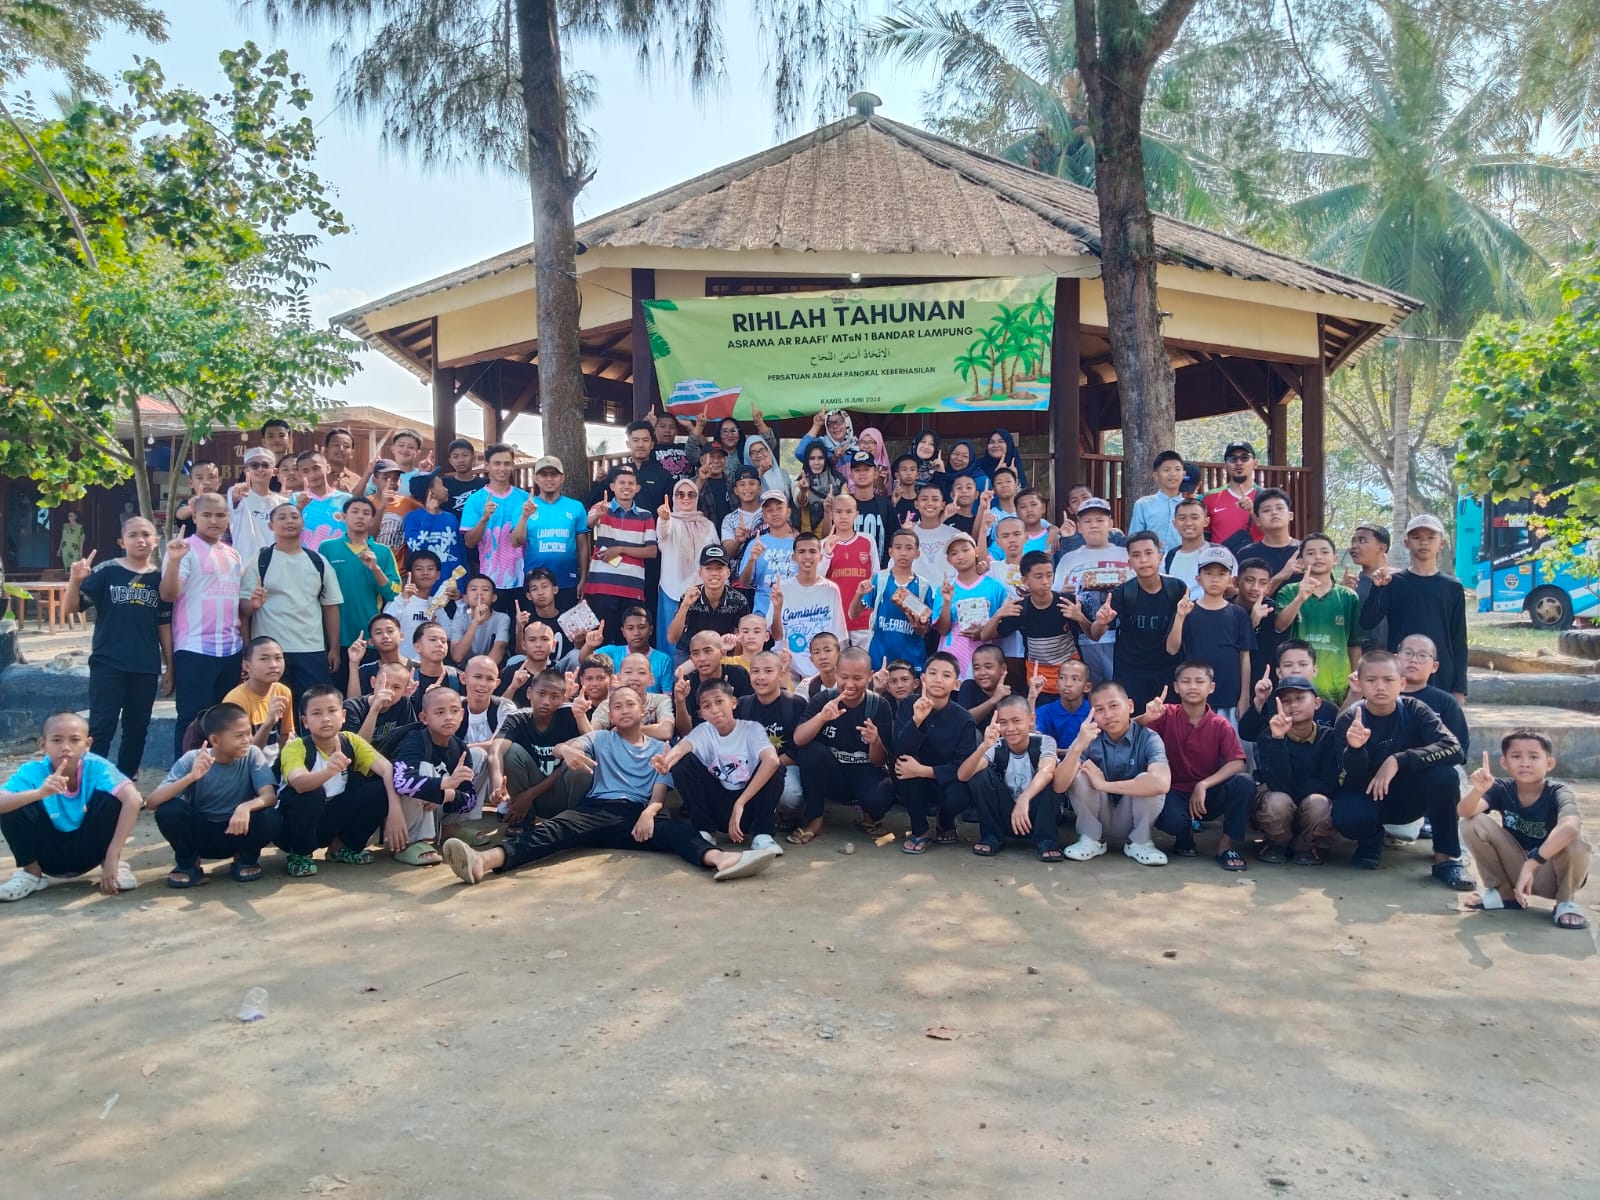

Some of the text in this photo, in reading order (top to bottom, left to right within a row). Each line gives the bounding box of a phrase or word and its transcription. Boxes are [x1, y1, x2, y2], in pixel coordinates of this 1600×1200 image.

[732, 300, 965, 332] RIHLAH TAHUNAN
[728, 338, 775, 349] ASRAMA
[778, 337, 792, 346] AR
[832, 333, 861, 343] MTsN
[864, 333, 869, 341] 1
[871, 330, 915, 340] BANDAR
[918, 326, 973, 338] LAMPUNG
[812, 371, 842, 379] ADALAH
[844, 369, 880, 377] PANGKAL
[881, 366, 936, 376] KEBERHASILAN
